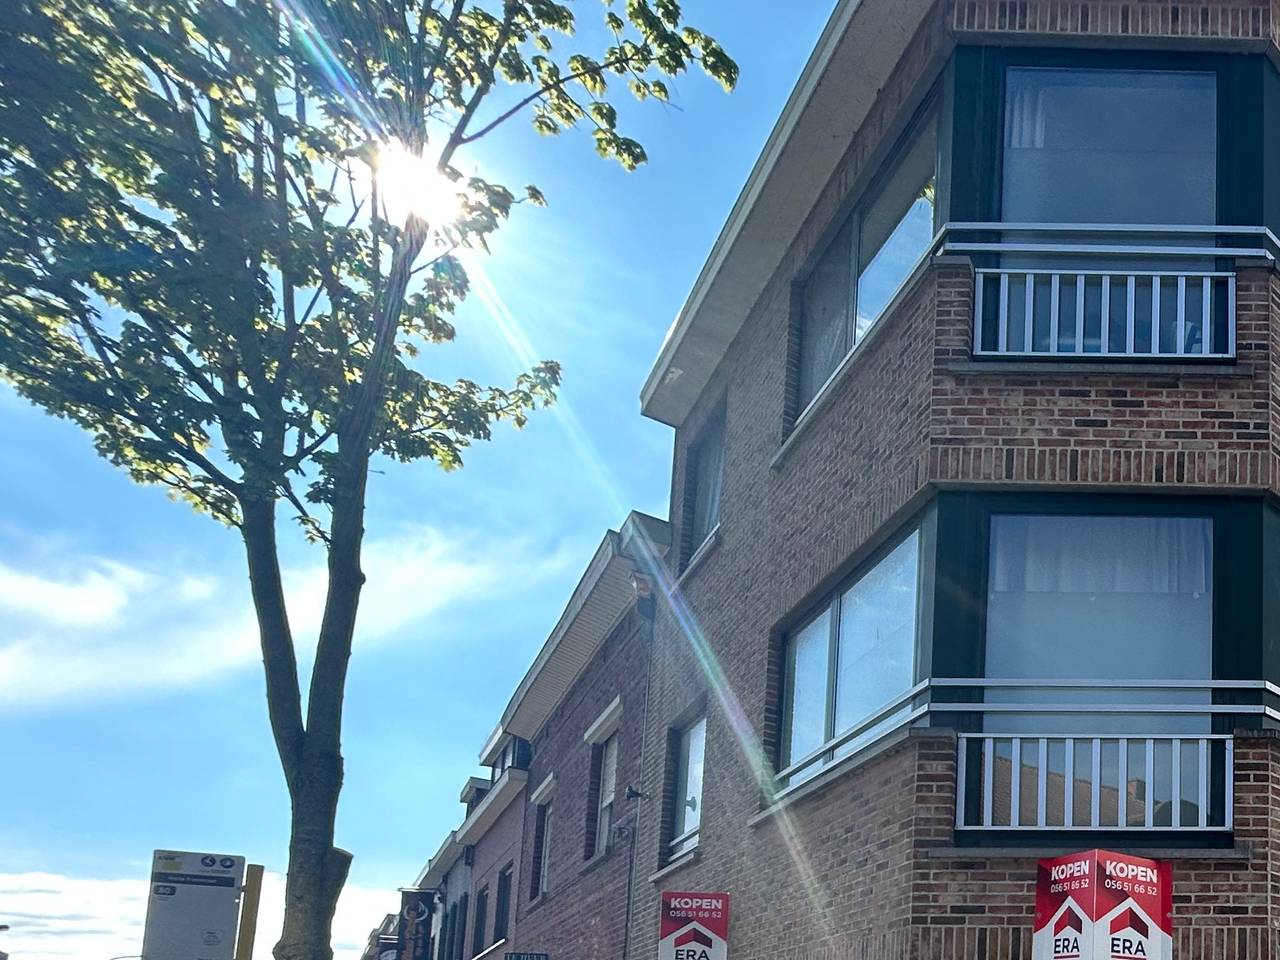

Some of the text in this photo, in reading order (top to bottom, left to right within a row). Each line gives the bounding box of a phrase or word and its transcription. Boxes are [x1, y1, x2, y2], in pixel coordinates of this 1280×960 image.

[1051, 860, 1090, 881] KOPEN
[1105, 860, 1158, 883] KOPEN
[1050, 882, 1063, 893] 056
[1063, 881, 1071, 891] 51
[1080, 878, 1089, 888] 52
[1104, 879, 1158, 896] 056 51 66 52
[670, 897, 723, 910] KOPEN
[669, 910, 687, 918] 056
[711, 911, 722, 919] 52
[1053, 937, 1080, 954] ERA
[1110, 937, 1147, 956] ERA
[674, 949, 710, 960] ERA
